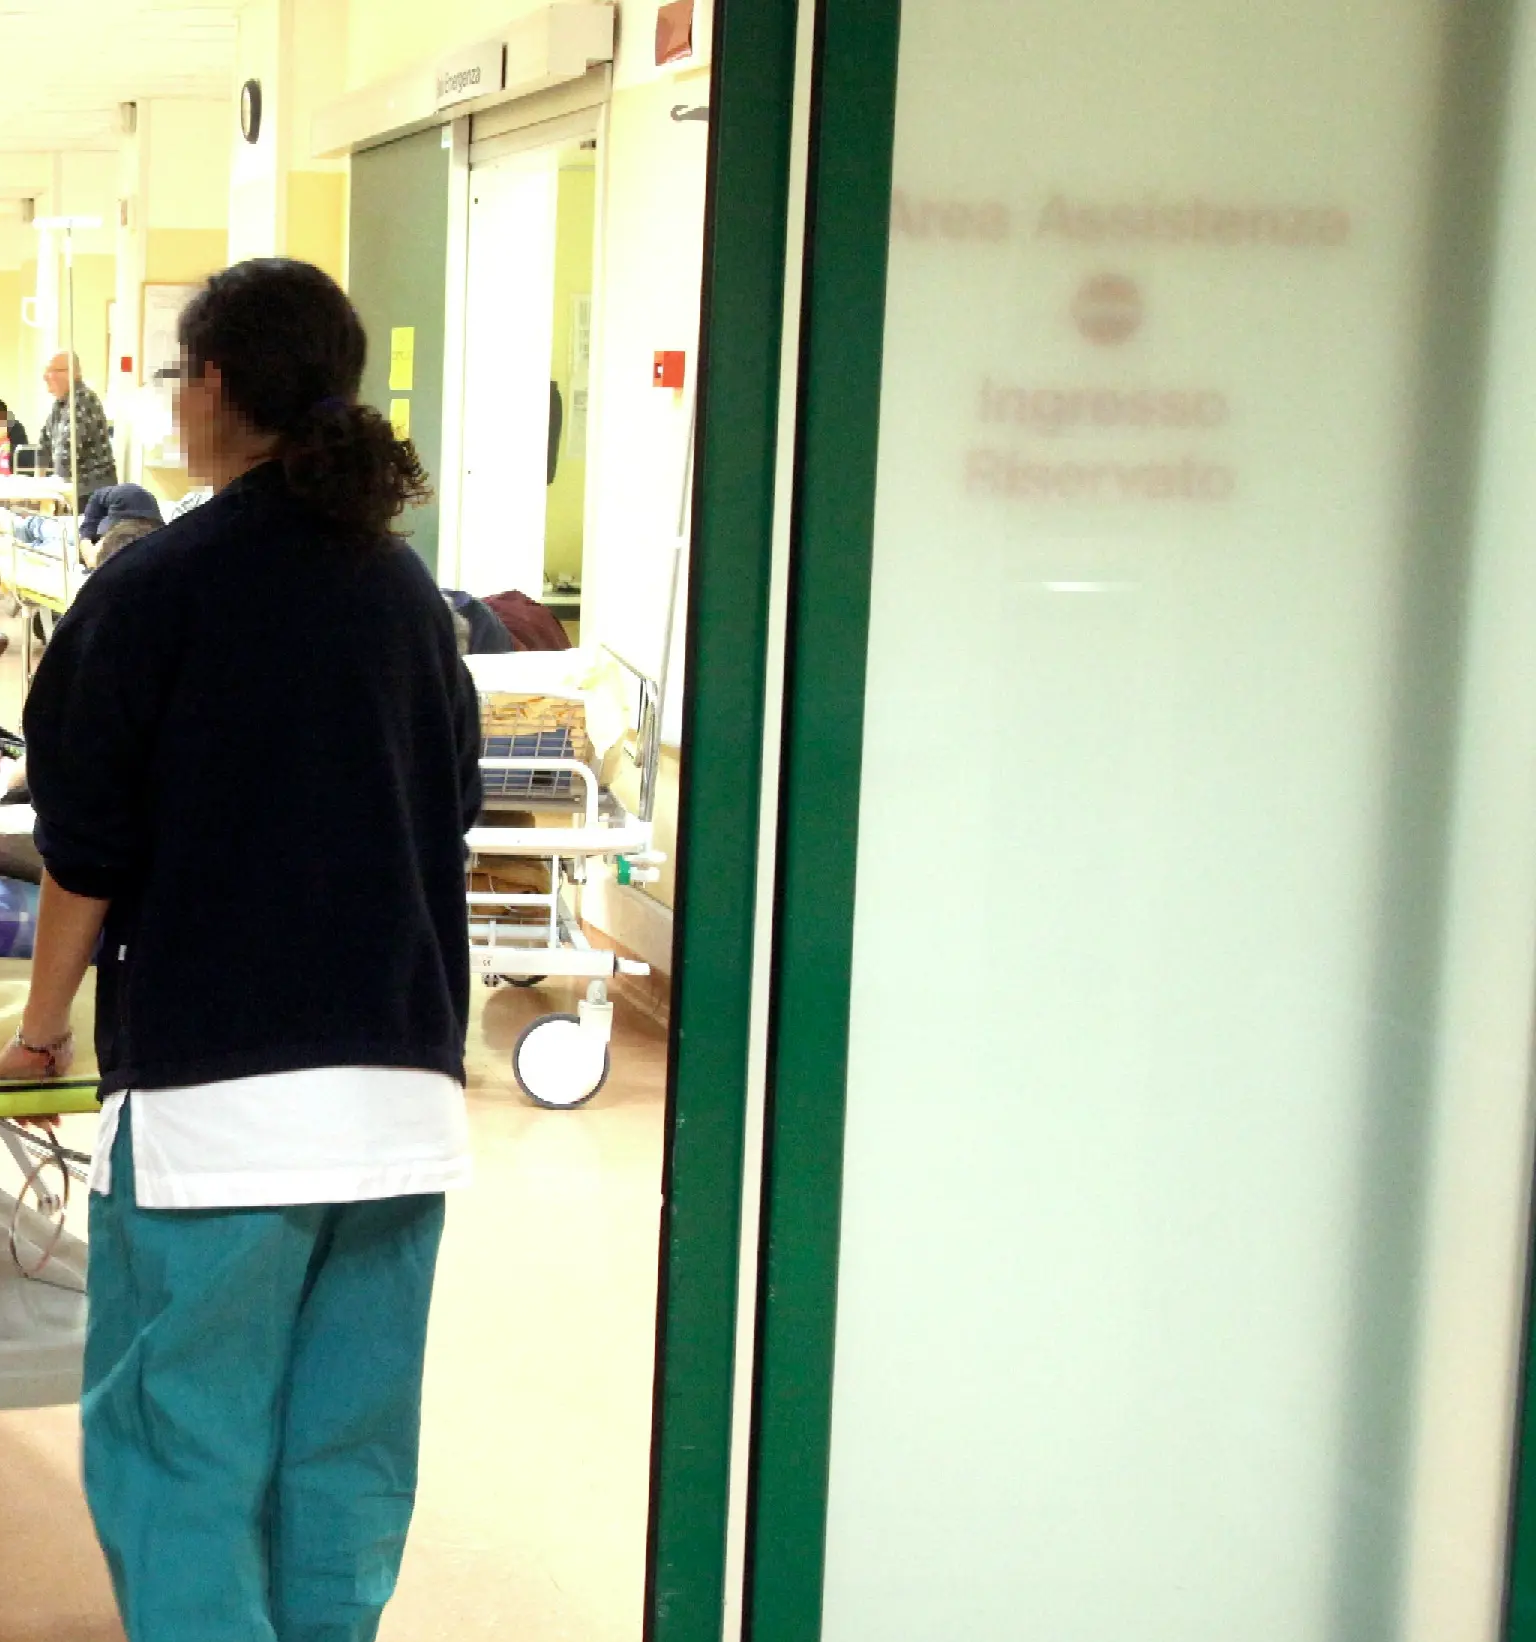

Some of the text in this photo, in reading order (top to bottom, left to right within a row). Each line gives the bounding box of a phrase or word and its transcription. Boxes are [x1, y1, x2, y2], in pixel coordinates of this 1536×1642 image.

[1034, 193, 1351, 248] Assistenza
[977, 376, 1230, 437] Ingresso
[963, 448, 1236, 502] Riservato
